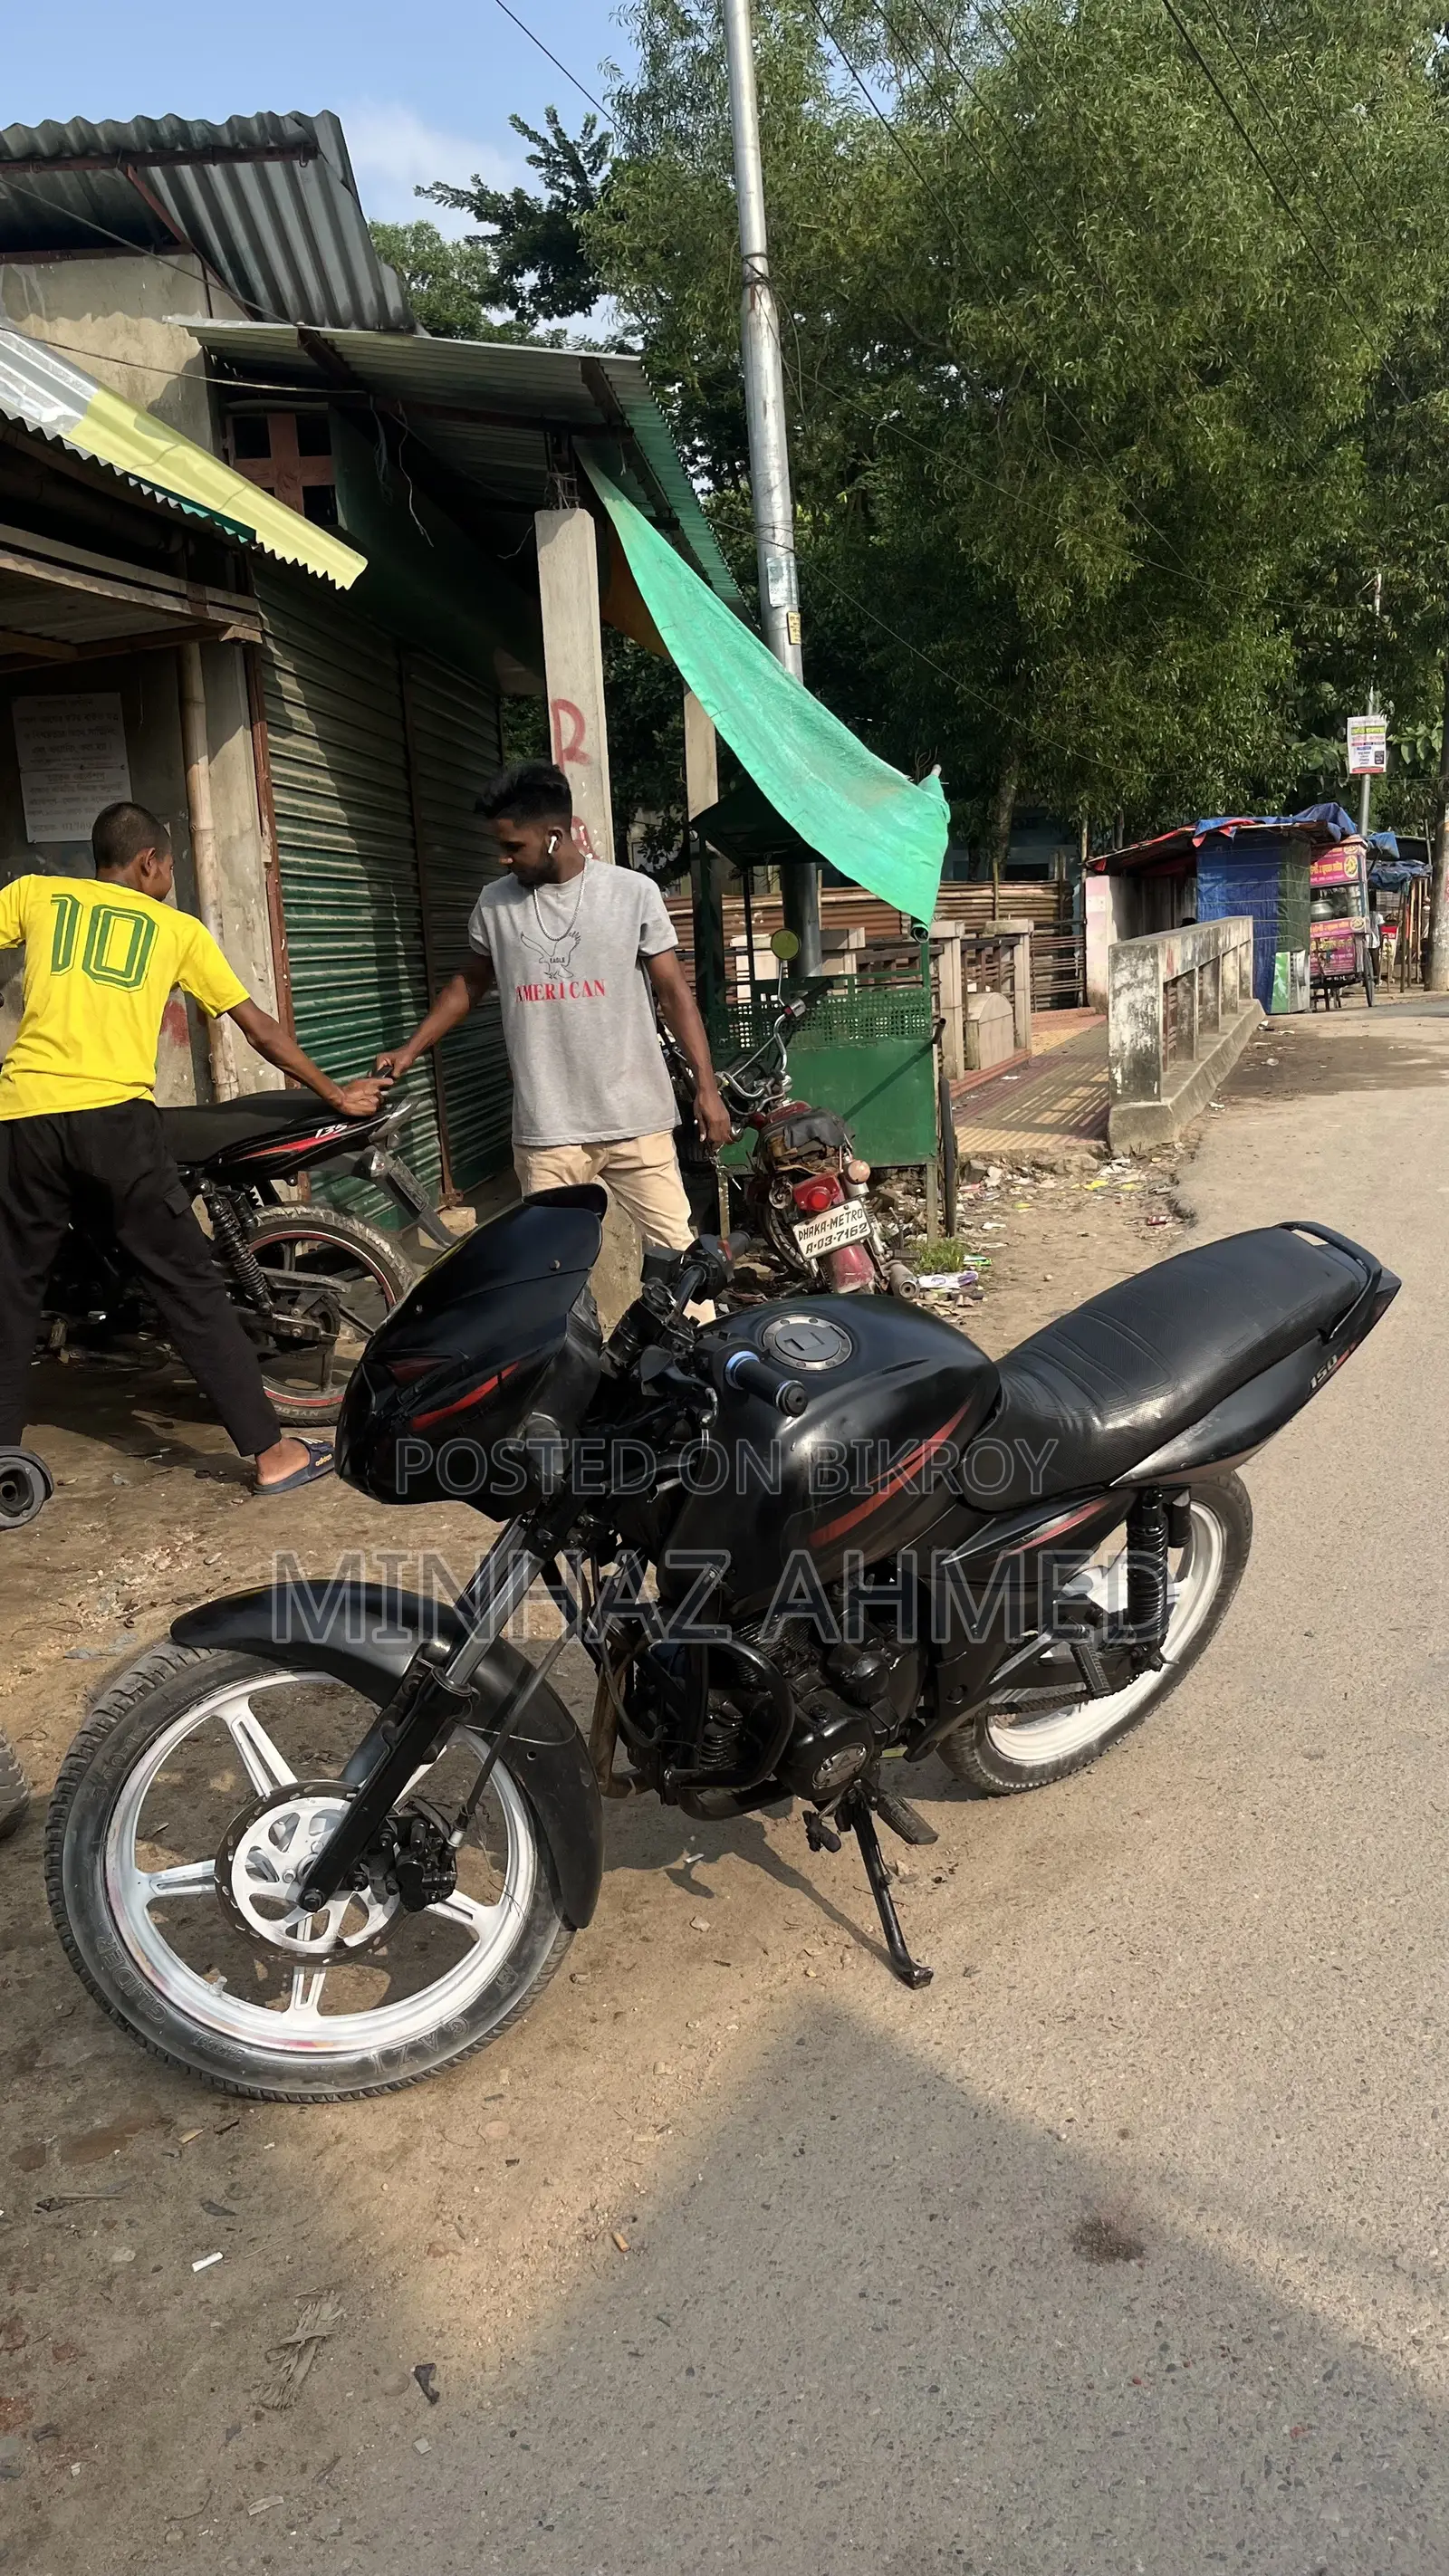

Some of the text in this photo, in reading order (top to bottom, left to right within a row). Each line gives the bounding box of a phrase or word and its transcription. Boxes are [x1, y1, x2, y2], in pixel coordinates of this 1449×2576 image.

[50, 893, 159, 992] 10
[515, 979, 606, 1003] AMERICAN
[315, 1124, 348, 1138] 135
[798, 1208, 863, 1242] DHAKA-METRO
[1310, 1354, 1338, 1389] 150
[95, 1932, 168, 2025] GLIDER
[369, 2016, 469, 2074] GAZI
